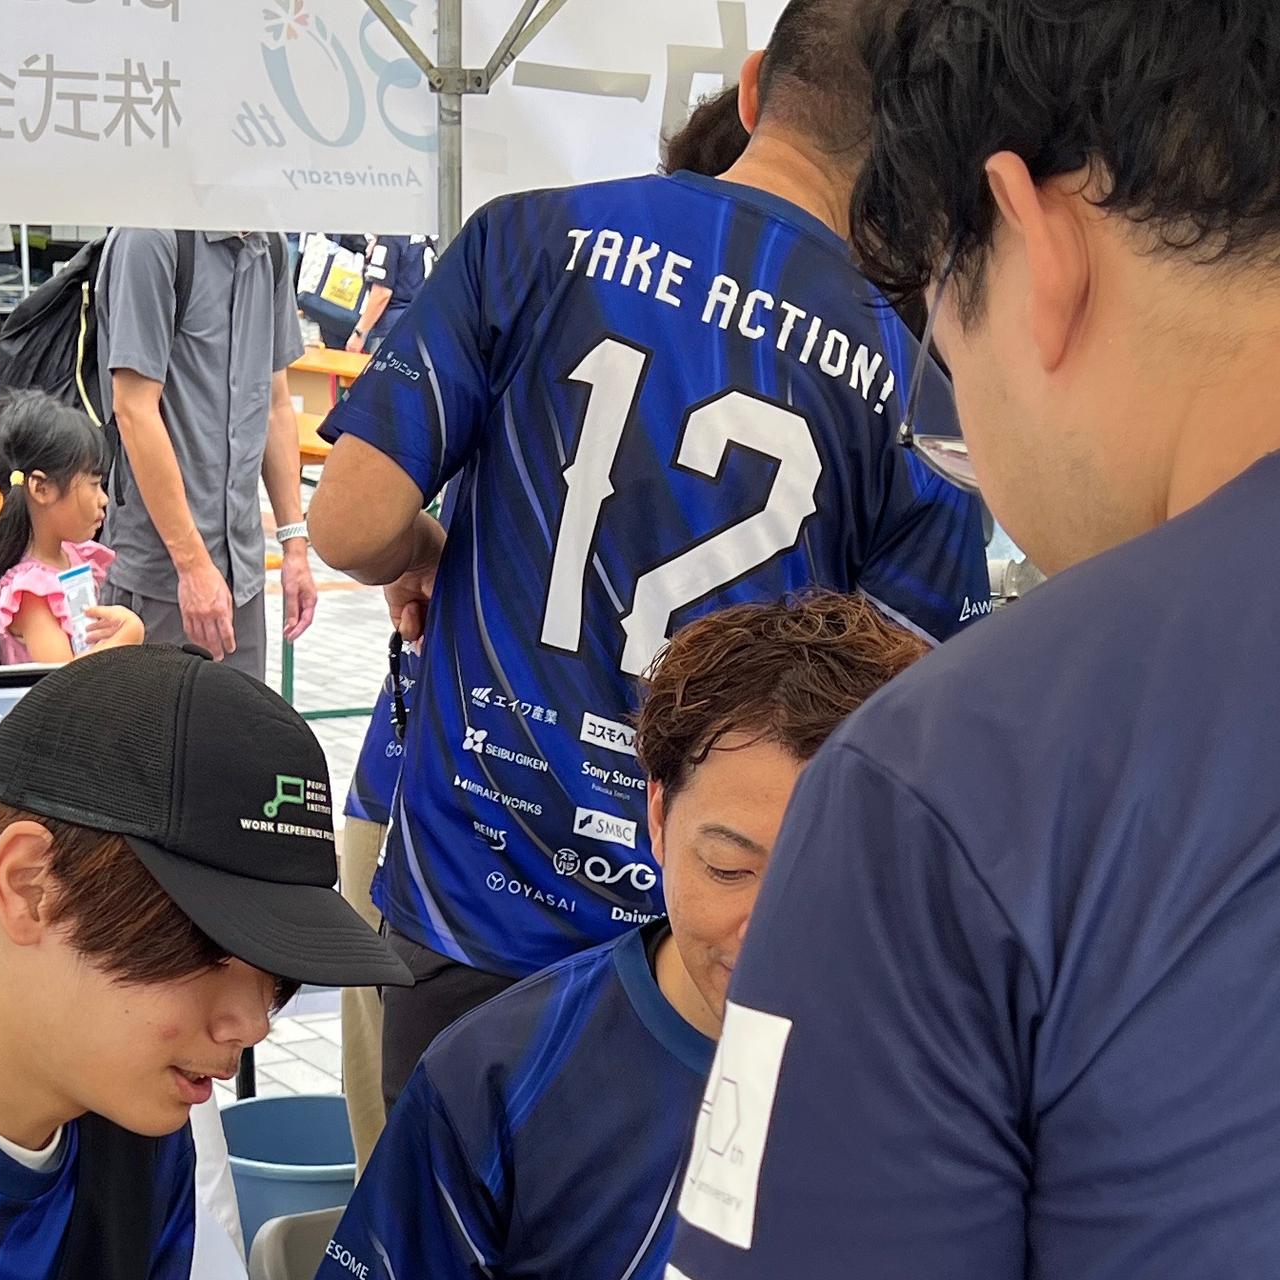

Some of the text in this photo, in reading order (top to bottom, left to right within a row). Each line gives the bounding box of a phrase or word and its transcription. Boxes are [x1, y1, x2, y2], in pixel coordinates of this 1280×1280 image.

[566, 228, 896, 415] TAKE ACTION!
[538, 335, 822, 680] 12
[485, 743, 549, 772] SEIBU GIKEN
[581, 761, 647, 790] Sony Store
[501, 794, 543, 816] WORKS
[240, 818, 275, 833] WORK
[596, 818, 633, 842] SMBC
[584, 856, 657, 891] OSG
[508, 880, 576, 913] OYASAI
